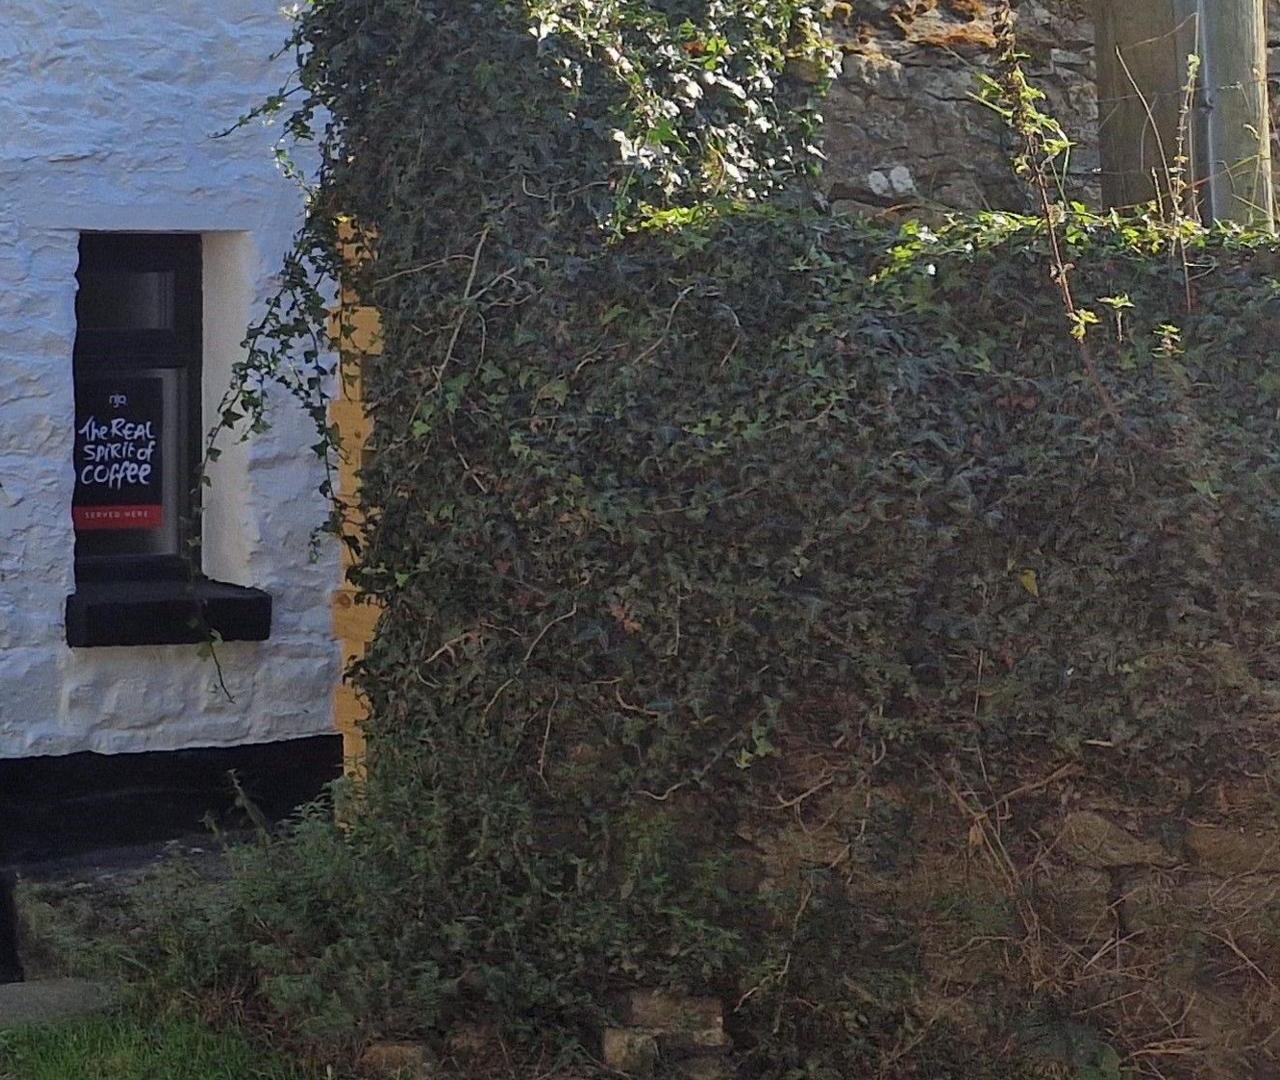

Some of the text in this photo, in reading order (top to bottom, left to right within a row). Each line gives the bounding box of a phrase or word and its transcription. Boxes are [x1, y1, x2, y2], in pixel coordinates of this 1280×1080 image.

[111, 418, 156, 440] REAL
[137, 440, 156, 461] of
[84, 510, 121, 519] SERVED
